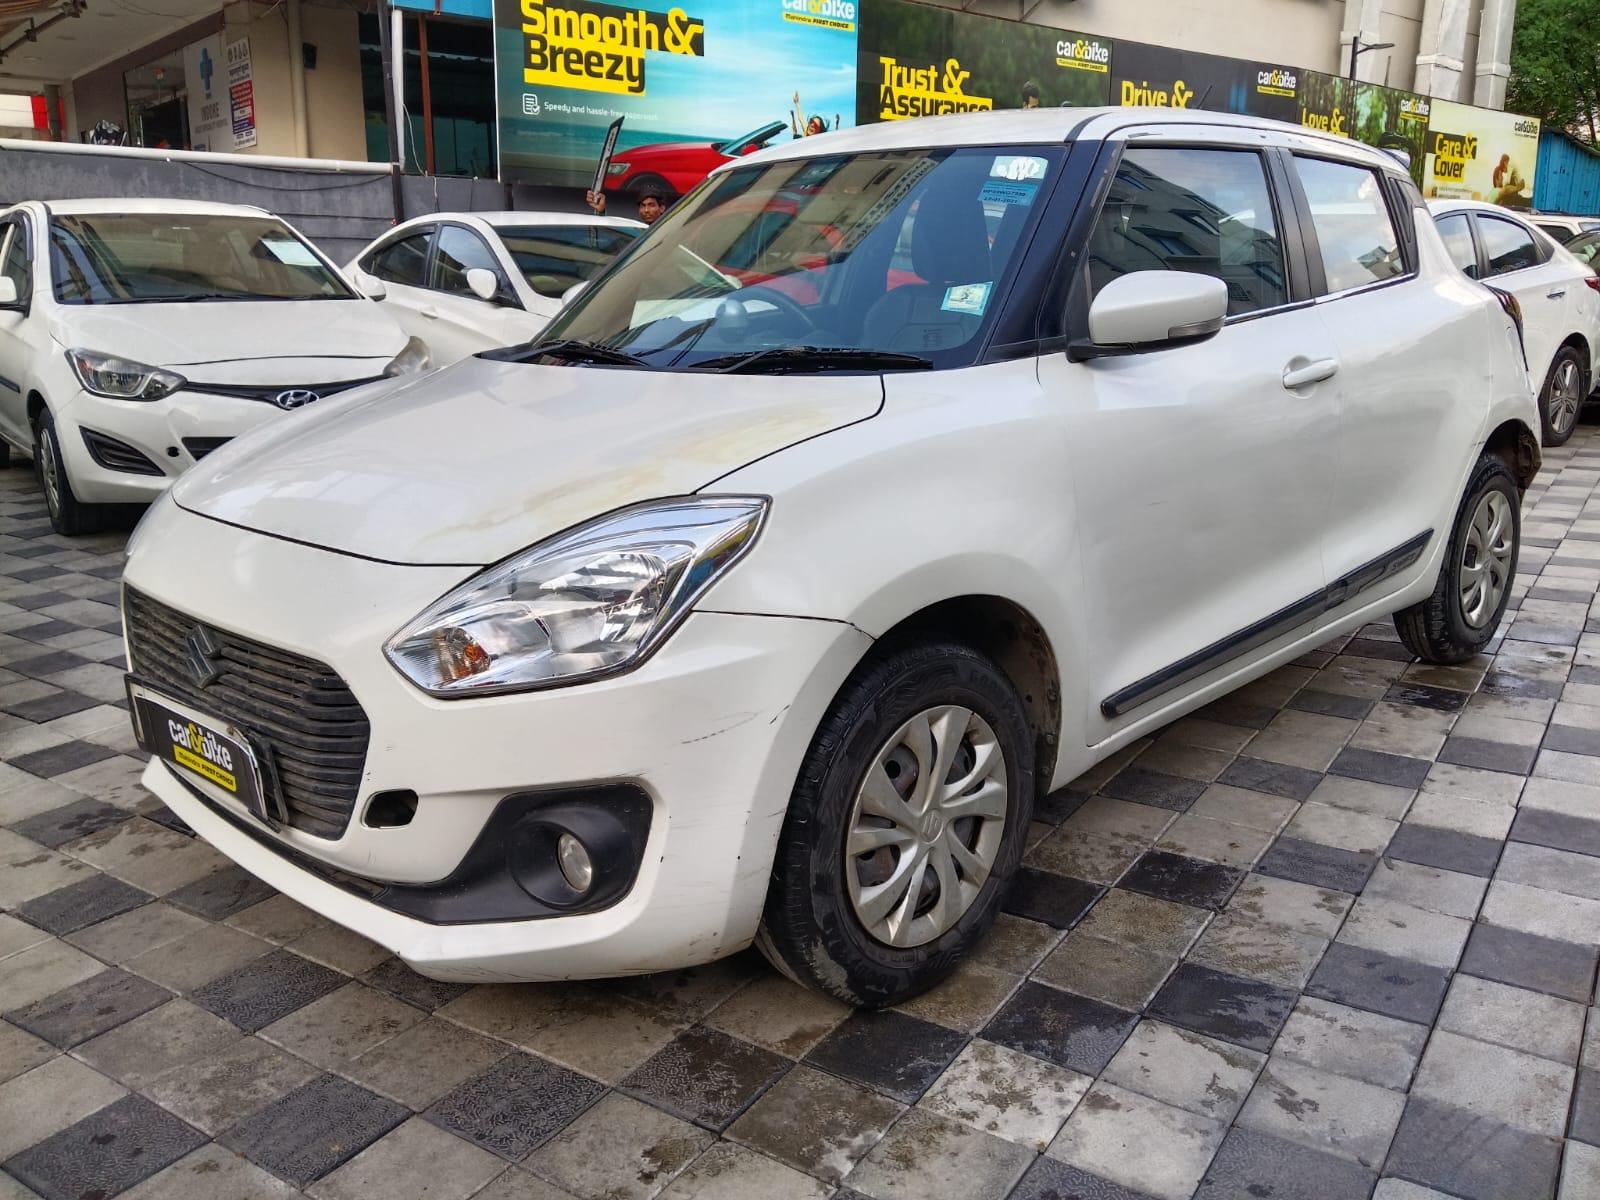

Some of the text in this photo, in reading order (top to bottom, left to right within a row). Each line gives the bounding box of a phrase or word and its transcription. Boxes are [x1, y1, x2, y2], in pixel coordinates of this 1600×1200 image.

[520, 0, 704, 57] Smooth &
[523, 33, 645, 94] Breezy
[1056, 39, 1109, 63] car&bike
[879, 56, 971, 96] Trust &
[1257, 69, 1296, 89] car&bike
[543, 101, 571, 115] Speedy
[572, 106, 585, 114] and
[1121, 80, 1194, 109] Drive &
[1302, 107, 1346, 133] Love &
[1435, 132, 1478, 160] Care &
[1433, 155, 1465, 178] Cover
[168, 719, 233, 771] car&bike
